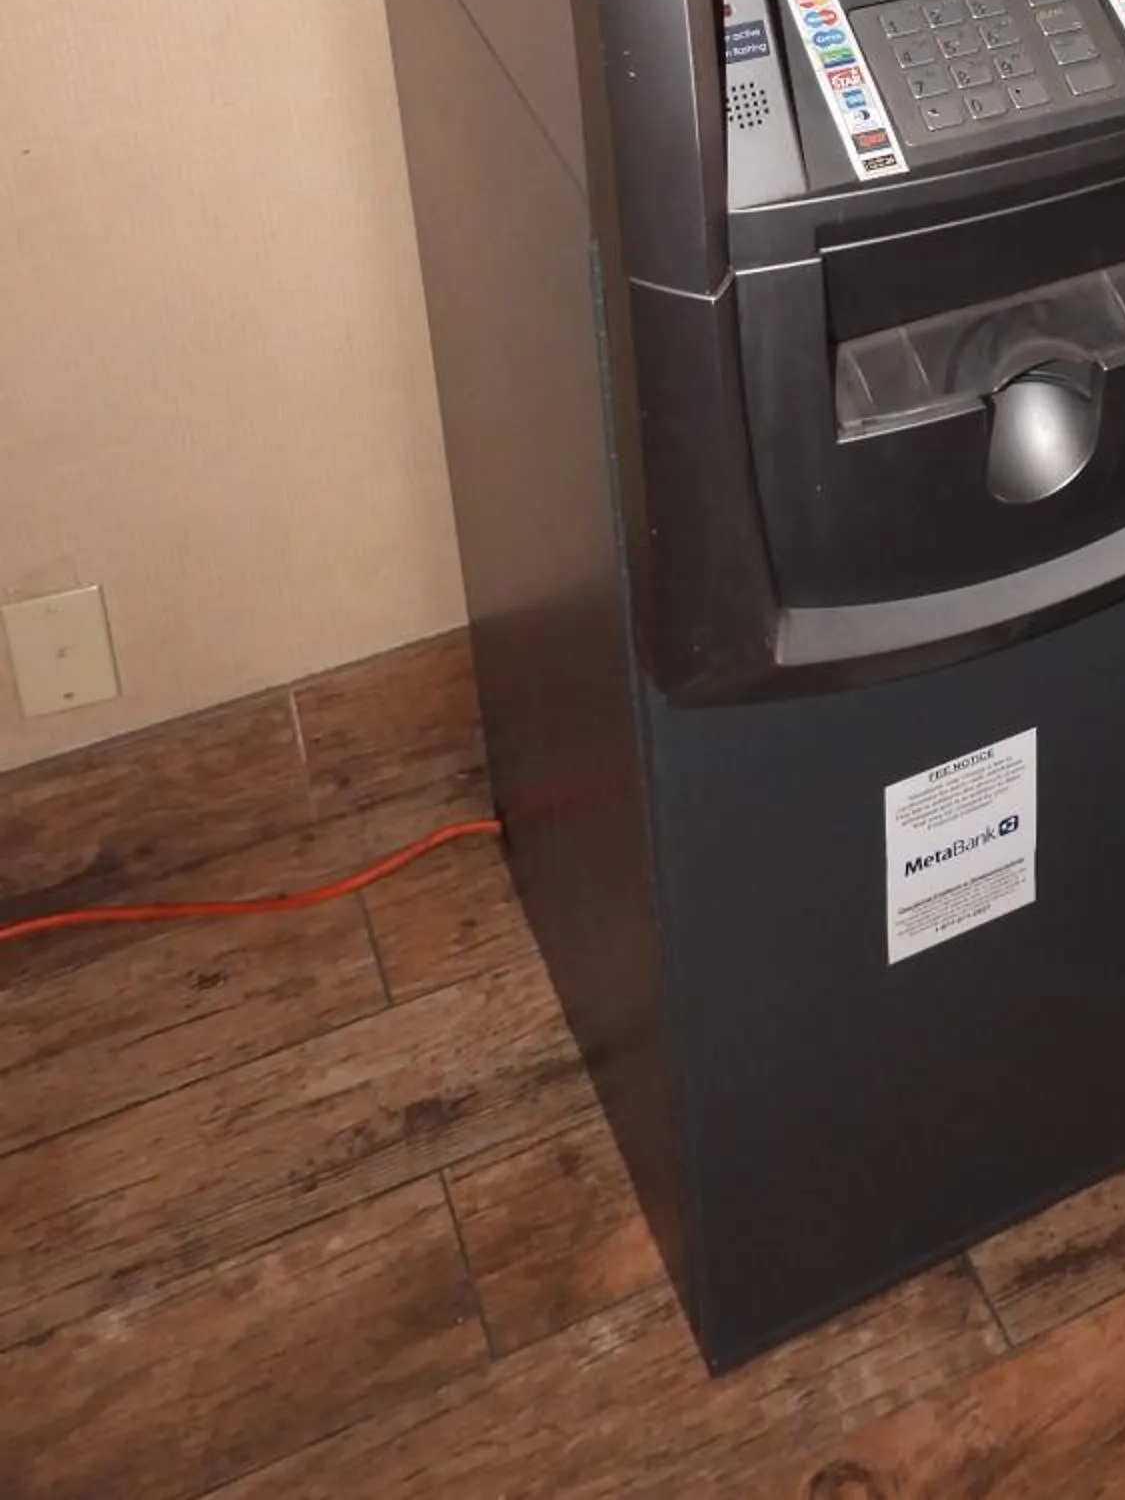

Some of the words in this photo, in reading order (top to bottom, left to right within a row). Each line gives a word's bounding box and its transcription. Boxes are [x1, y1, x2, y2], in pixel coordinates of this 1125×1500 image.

[732, 29, 761, 40] active
[733, 43, 767, 56] flashing
[928, 766, 952, 783] FEE
[953, 748, 995, 771] NOTICE
[903, 825, 998, 878] MetaBank
